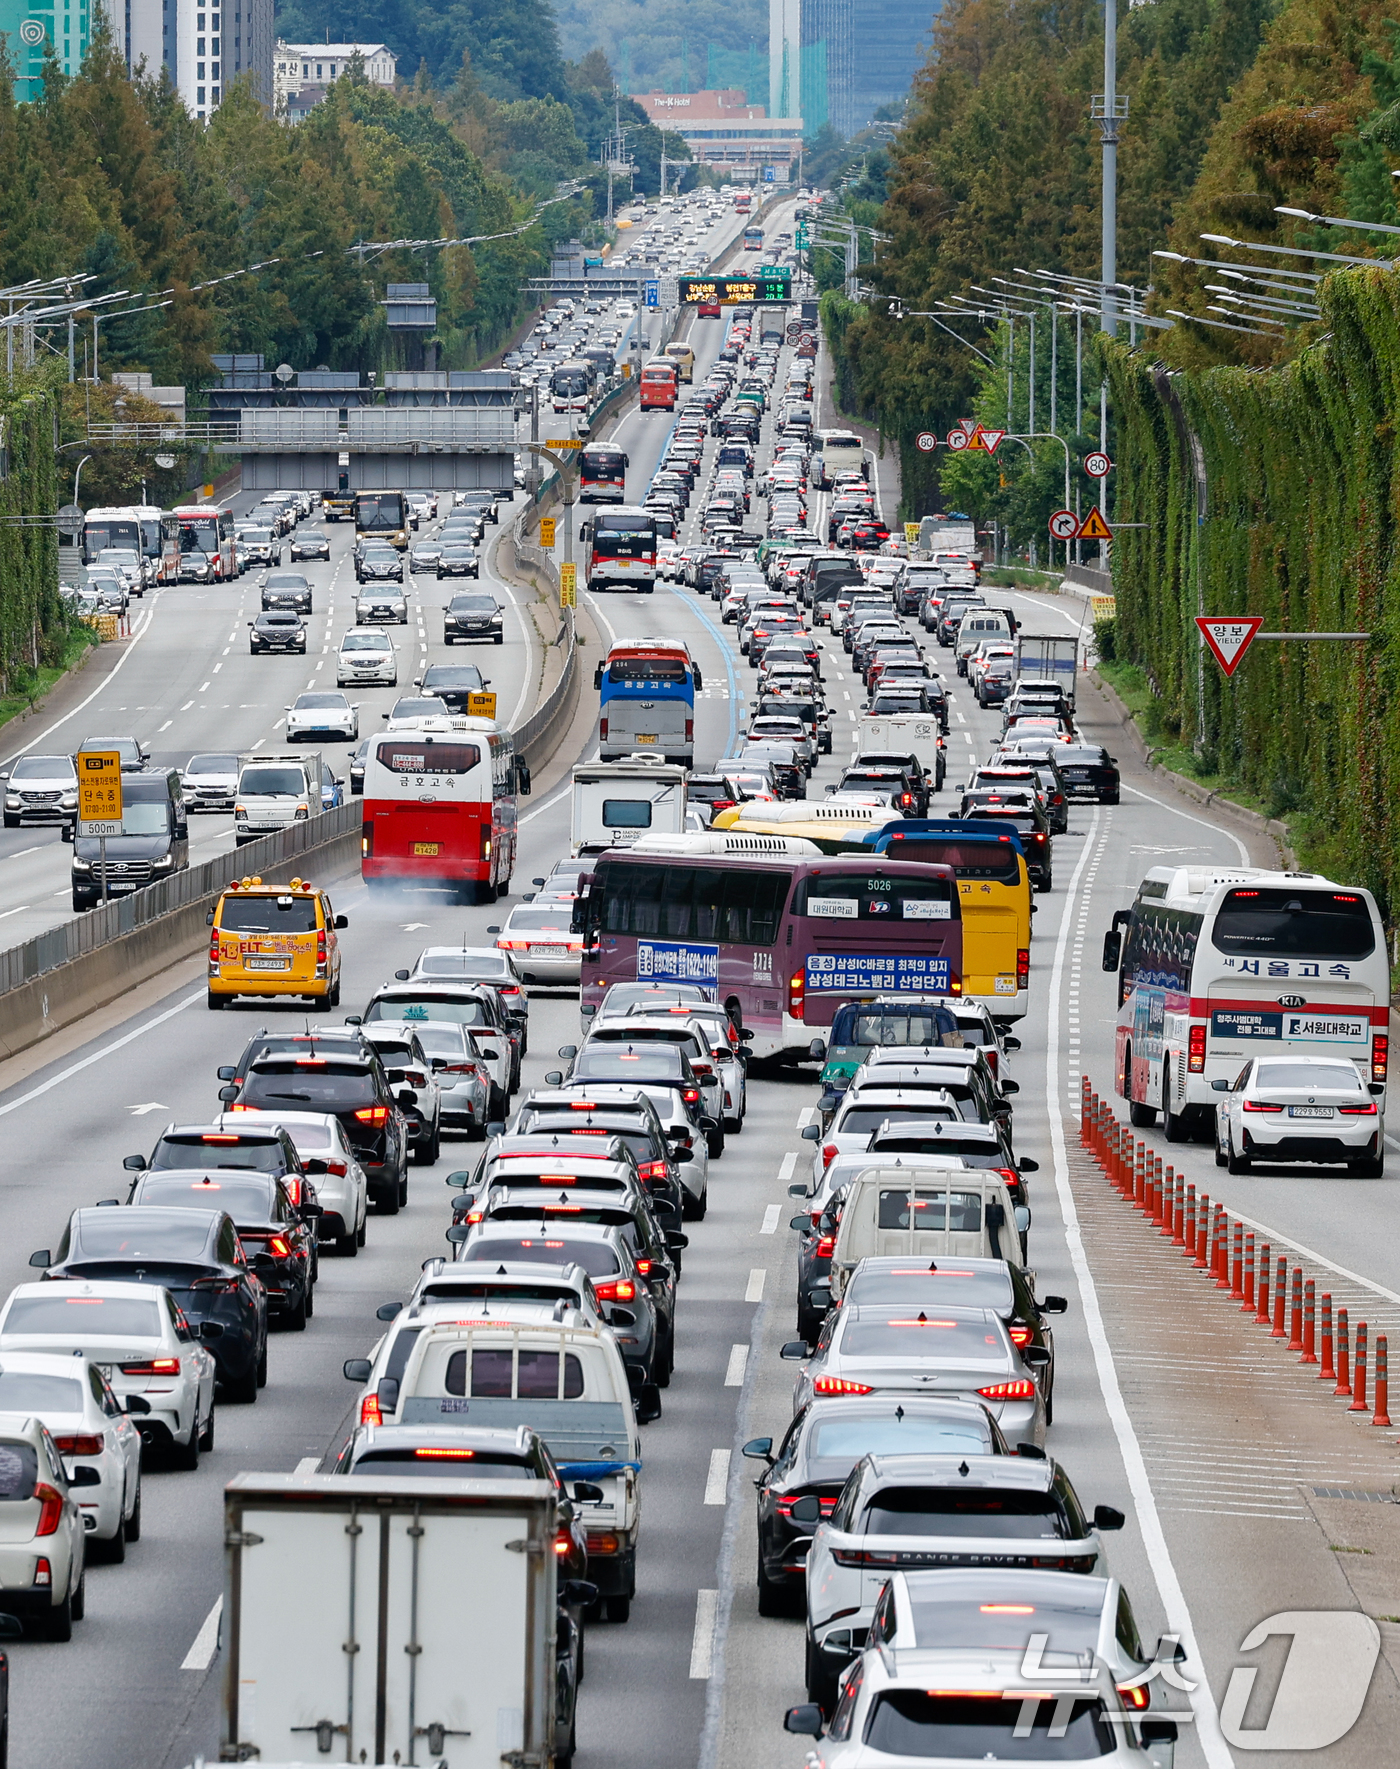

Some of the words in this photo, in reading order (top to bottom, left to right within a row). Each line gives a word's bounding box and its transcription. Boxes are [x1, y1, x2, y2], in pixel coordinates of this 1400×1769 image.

[674, 97, 691, 107] Hotel
[765, 284, 775, 292] 15
[920, 437, 933, 448] 80
[1090, 459, 1105, 471] 80
[1213, 625, 1244, 637] 양보
[624, 681, 672, 689] 중앙고속
[399, 777, 456, 789] 금호고속
[84, 789, 115, 802] 단속중
[88, 823, 115, 834] 500m
[867, 879, 892, 891] 5026
[813, 904, 853, 915] 대원대학교
[808, 956, 834, 970] 음성
[837, 958, 896, 971] 삼성IC바로옆
[898, 959, 926, 972] 최적의
[929, 960, 948, 972] 입지
[808, 973, 895, 989] 삼성테크노밸리
[899, 975, 948, 989] 산업단지
[1281, 996, 1302, 1006] KIA
[1216, 1014, 1262, 1026] 청주사범대학
[1253, 1026, 1277, 1036] 그대로
[1302, 1021, 1362, 1036] 서원대학교
[902, 1553, 960, 1561] RANGE
[970, 1555, 1027, 1564] ROVER
